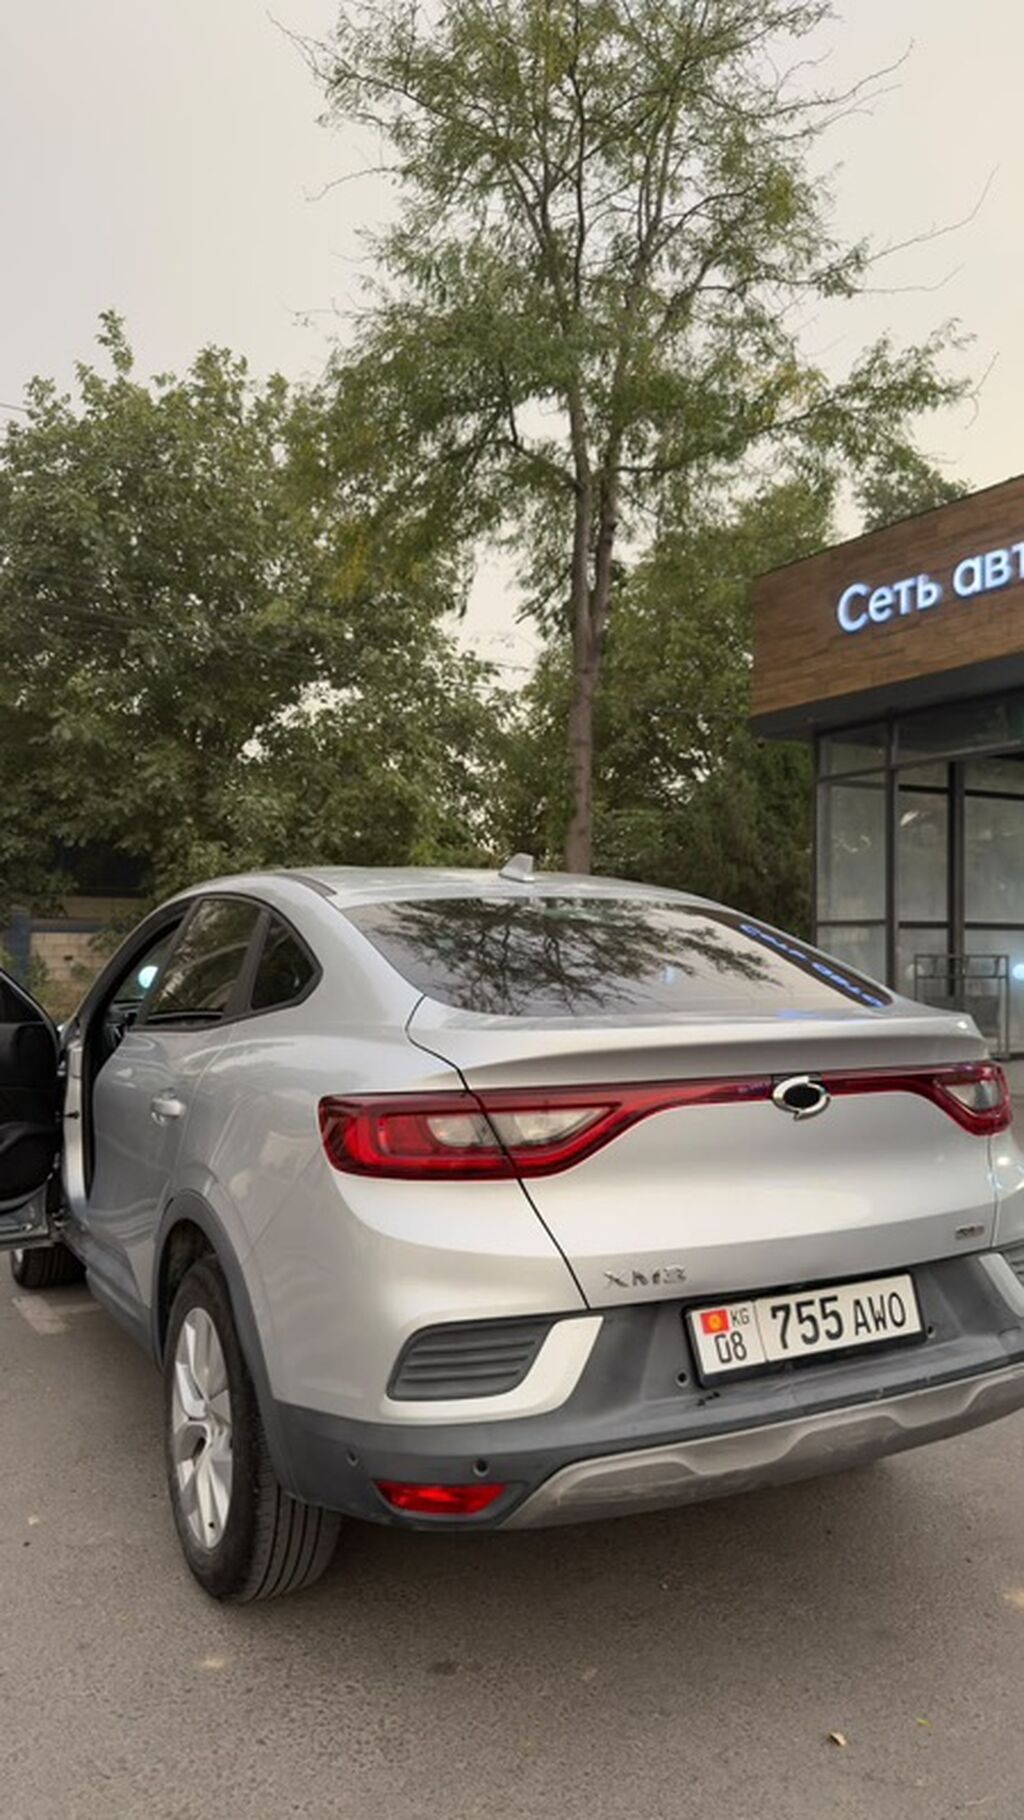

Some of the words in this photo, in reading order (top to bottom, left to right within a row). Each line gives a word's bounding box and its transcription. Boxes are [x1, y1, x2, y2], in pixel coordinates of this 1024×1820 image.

[838, 575, 942, 632] Сеть
[731, 1307, 750, 1326] KG
[771, 1296, 844, 1350] 755
[853, 1291, 906, 1336] AWO
[714, 1331, 747, 1364] 08
